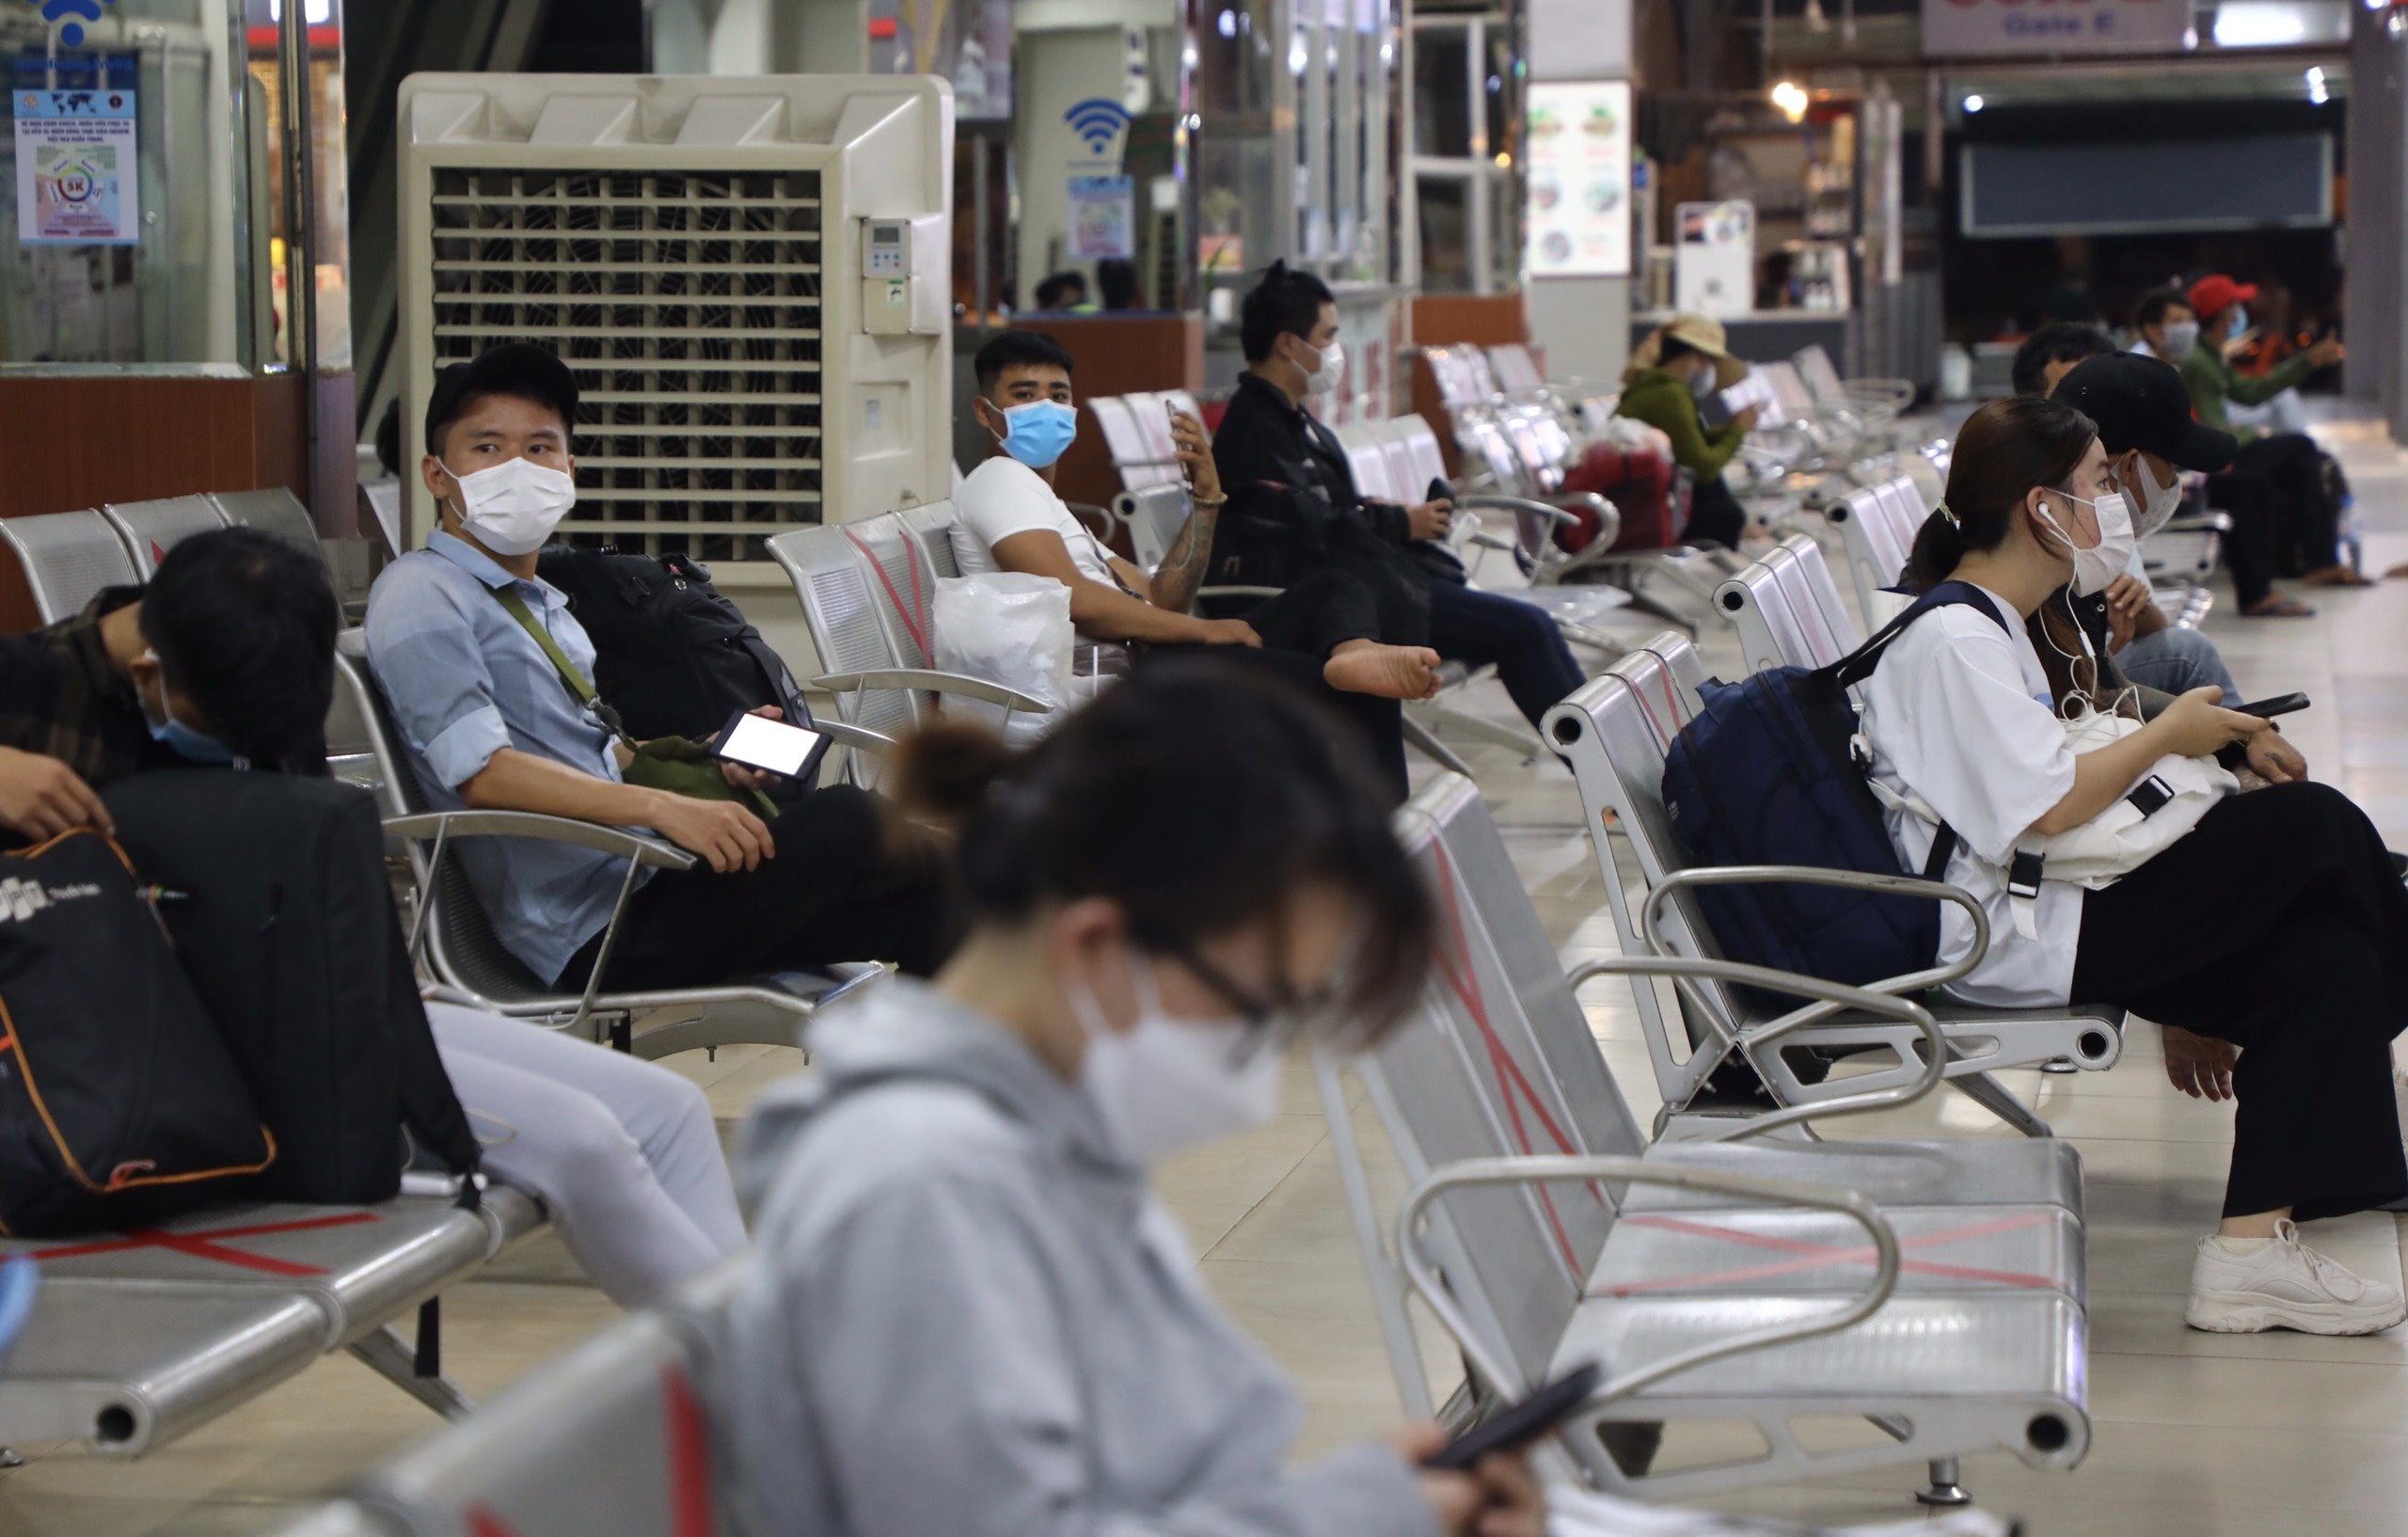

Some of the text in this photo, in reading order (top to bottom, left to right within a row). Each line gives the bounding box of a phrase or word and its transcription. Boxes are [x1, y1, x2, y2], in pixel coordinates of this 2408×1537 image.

[2004, 11, 2114, 36] Gate E
[67, 181, 84, 192] 5K
